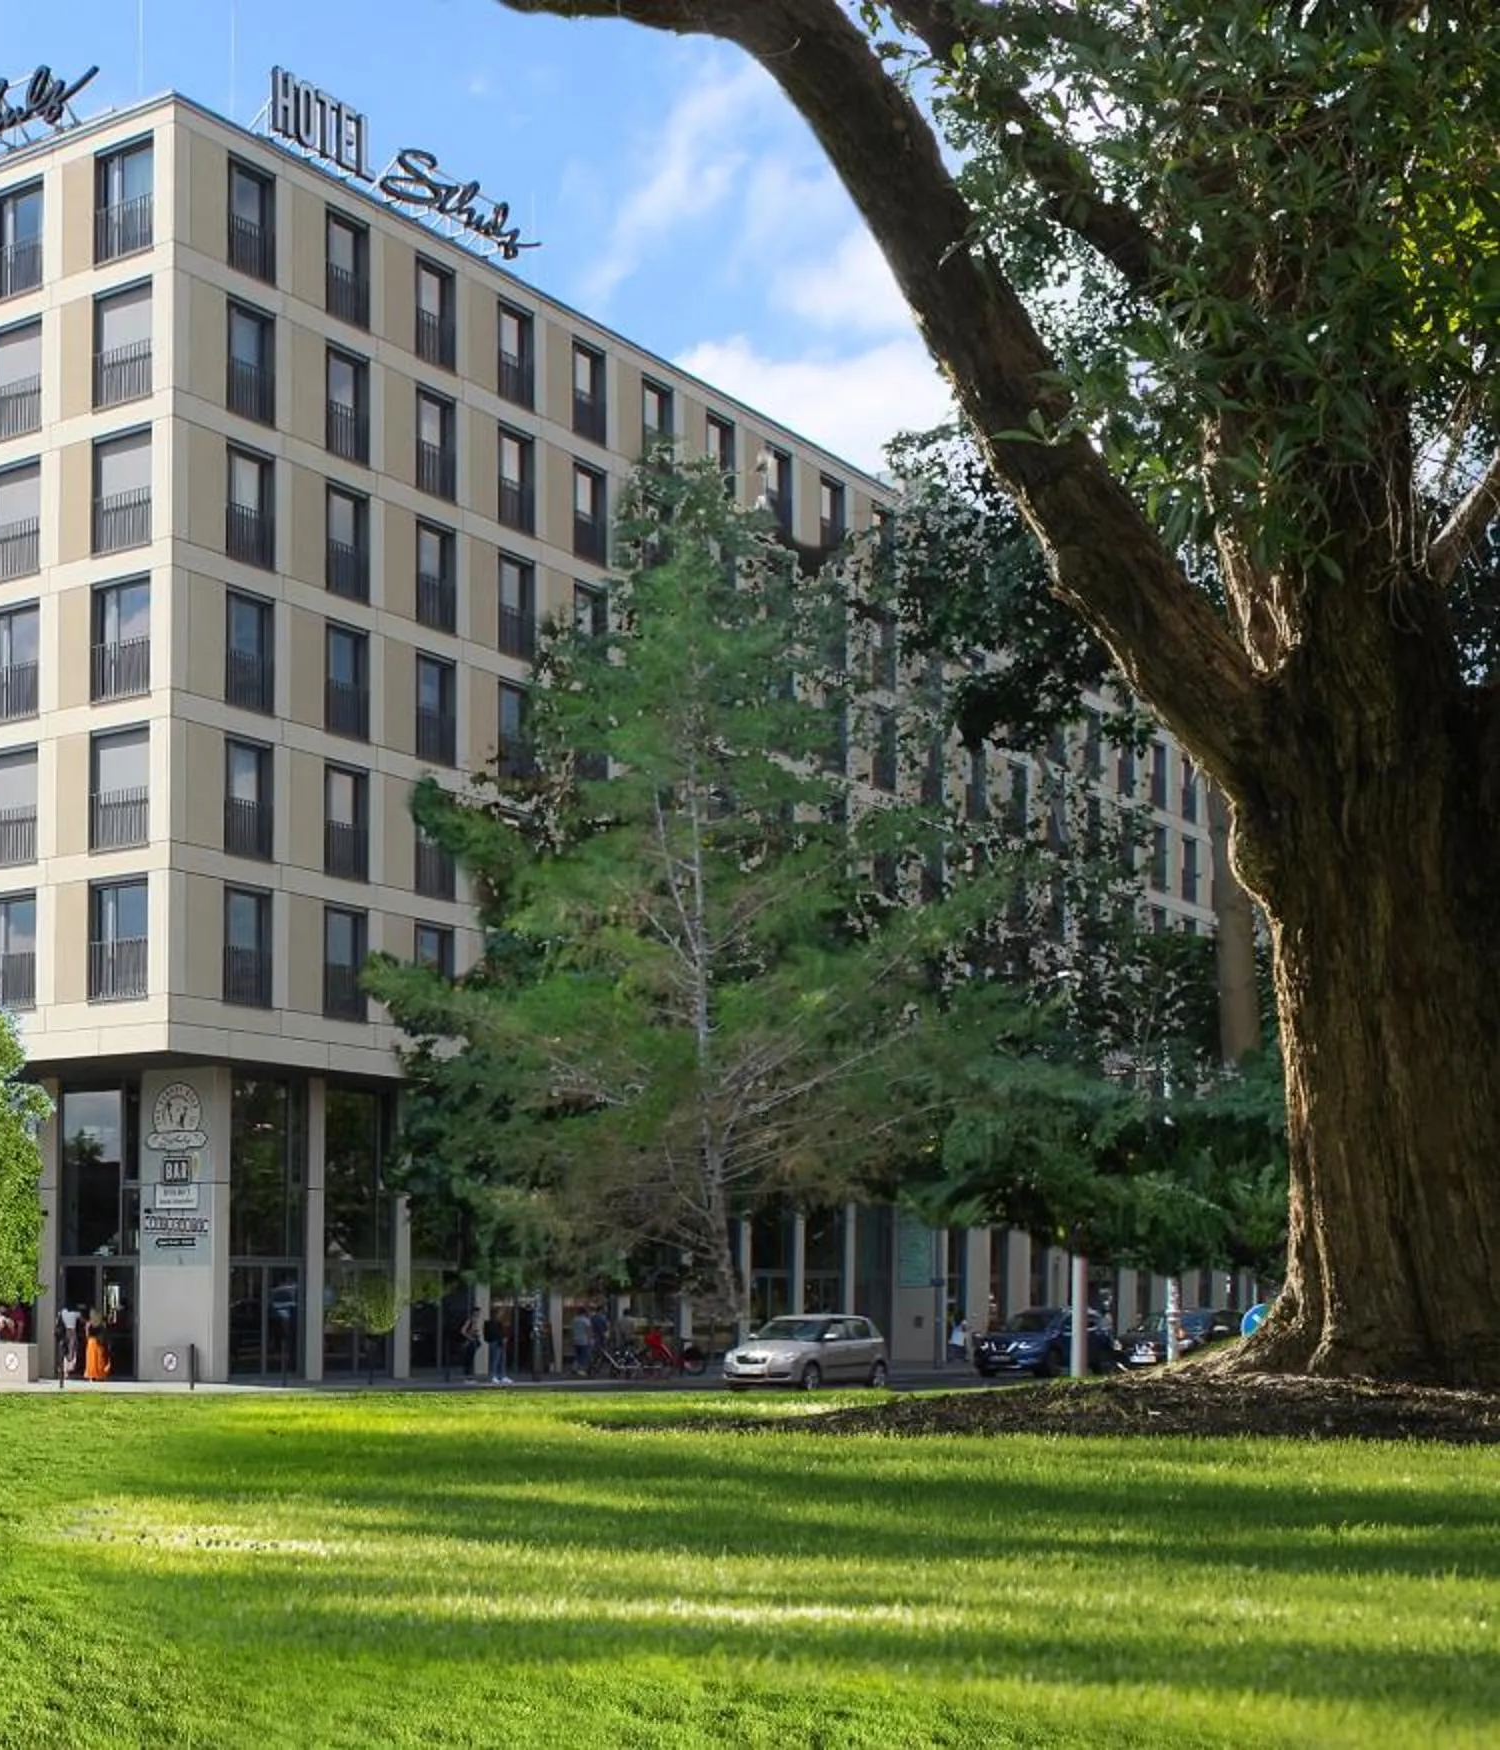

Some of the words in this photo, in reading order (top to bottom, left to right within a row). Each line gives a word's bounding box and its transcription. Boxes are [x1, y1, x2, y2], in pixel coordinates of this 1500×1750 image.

[270, 65, 376, 183] HOTEL
[380, 148, 543, 260] Schulz
[164, 1160, 189, 1180] BAR
